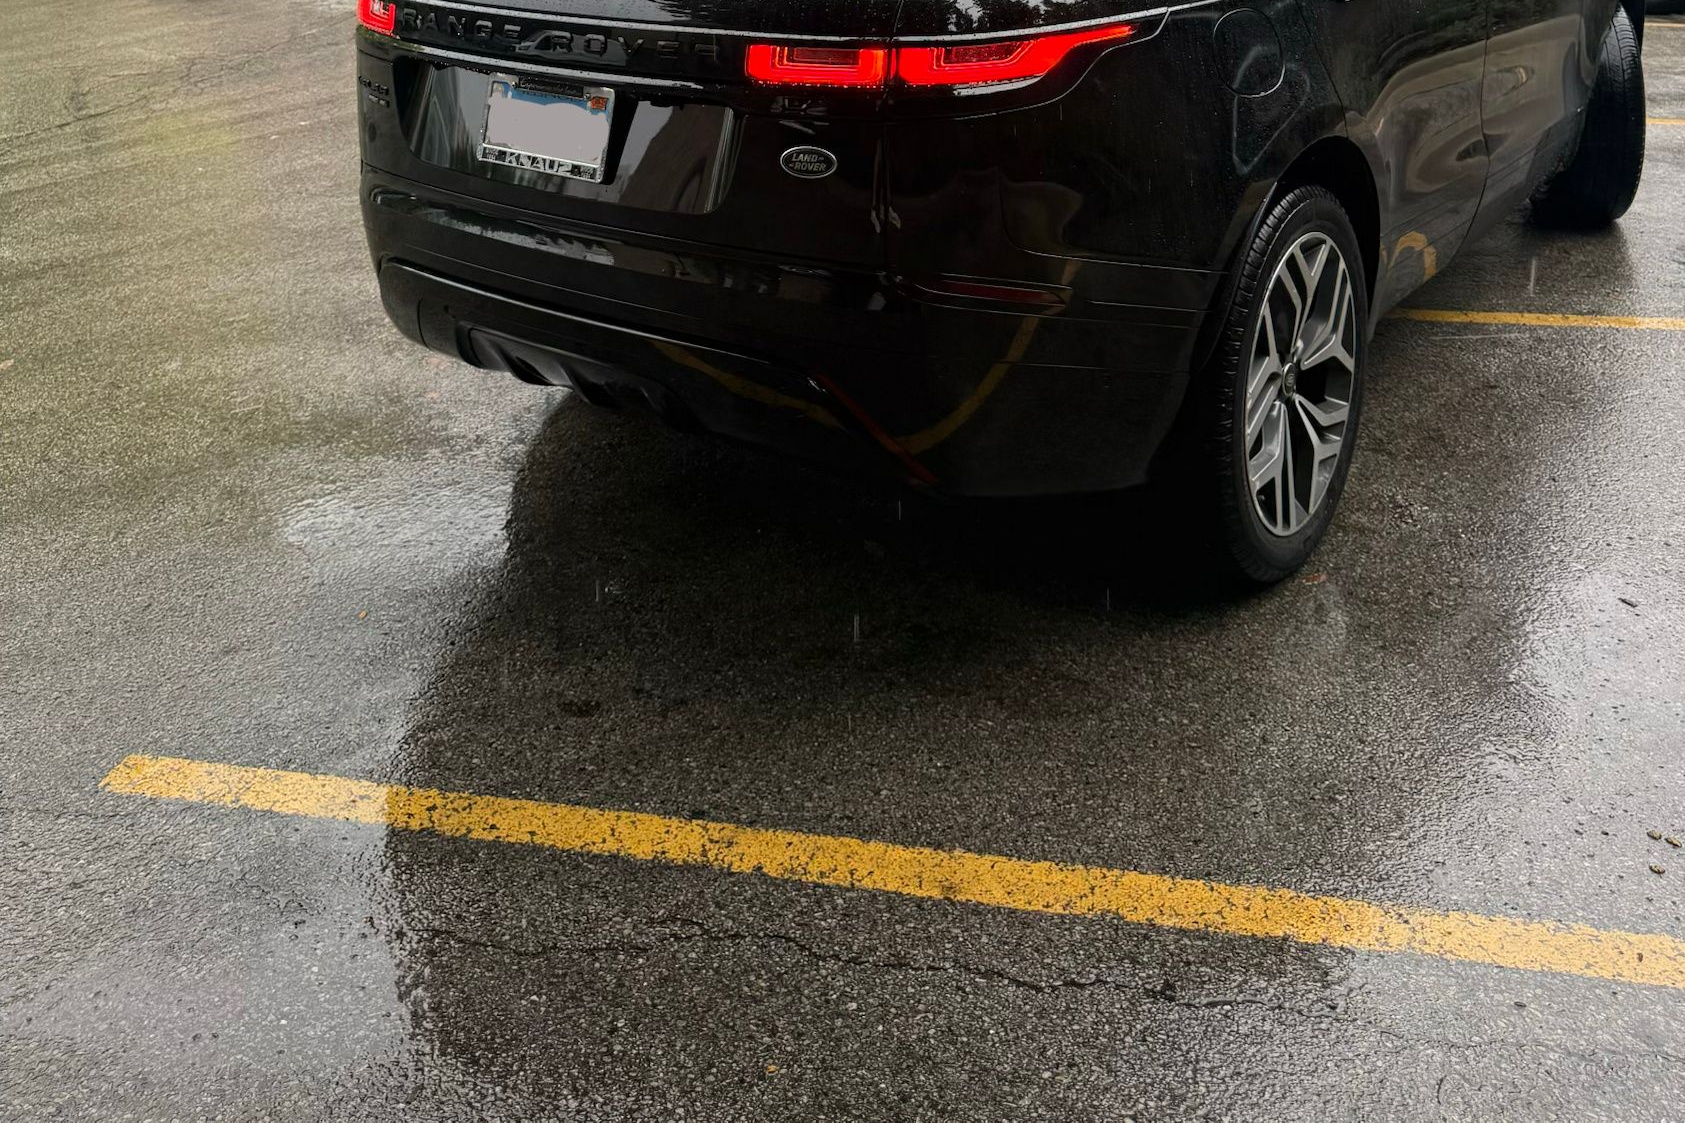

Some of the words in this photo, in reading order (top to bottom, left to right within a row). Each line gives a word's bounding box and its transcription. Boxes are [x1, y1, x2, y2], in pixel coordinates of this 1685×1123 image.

[402, 7, 521, 41] RANGE
[551, 30, 719, 61] ROVER
[505, 152, 573, 176] KNAUZ
[792, 153, 818, 163] LAND
[794, 162, 827, 171] ROVER
